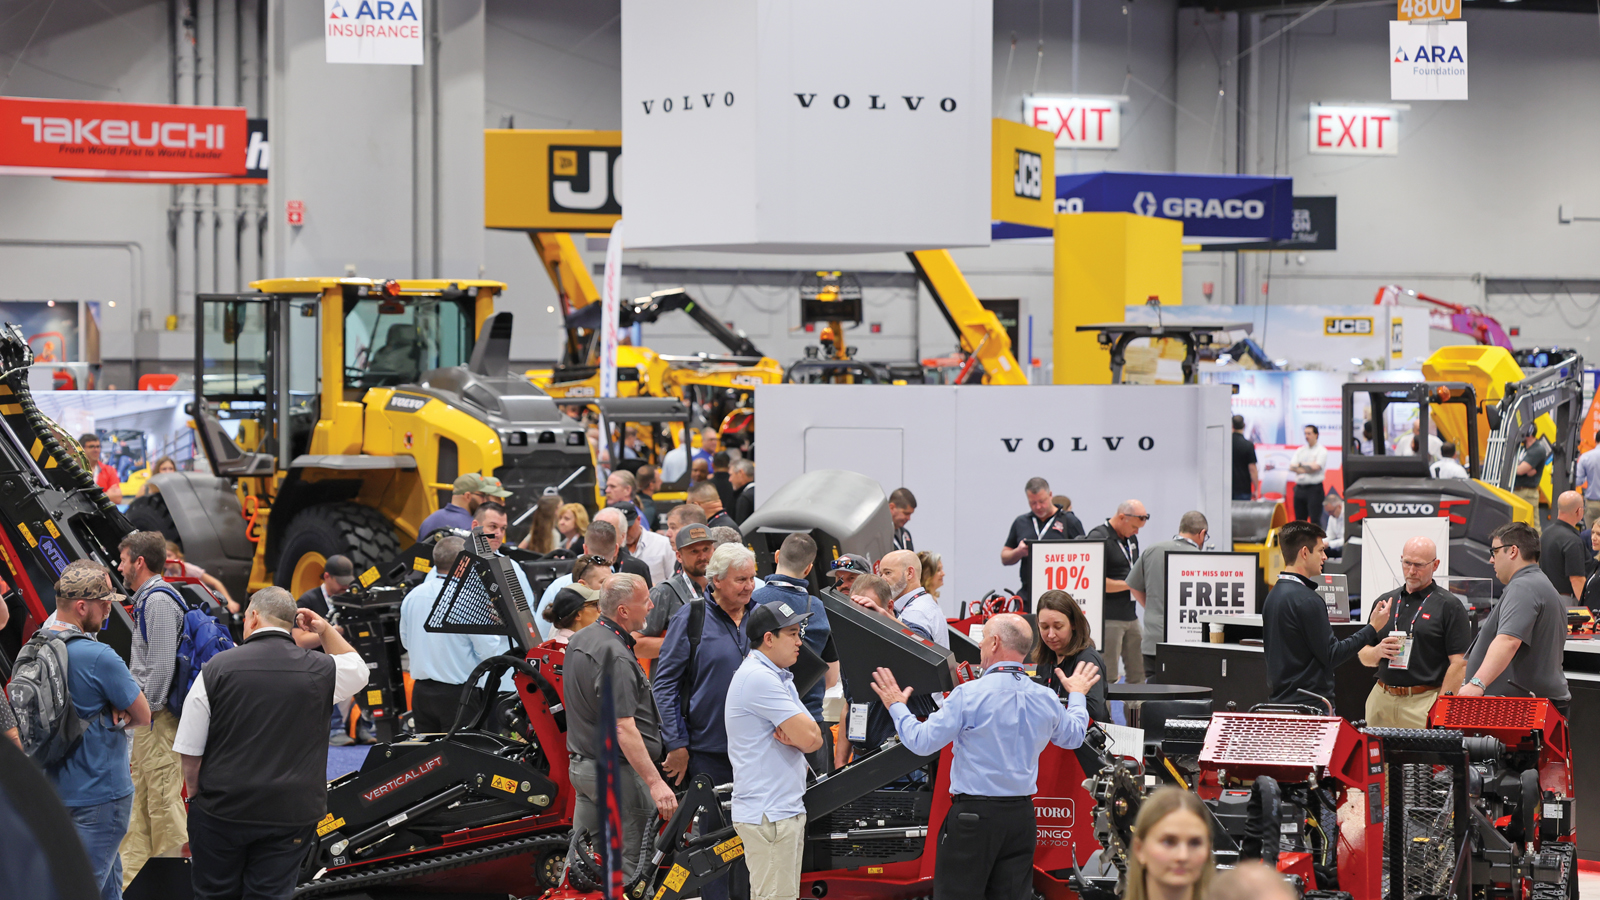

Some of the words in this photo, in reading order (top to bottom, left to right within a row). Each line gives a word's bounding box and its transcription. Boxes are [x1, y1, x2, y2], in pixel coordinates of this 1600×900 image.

[354, 0, 419, 21] ARA
[1400, 0, 1455, 17] 4800
[328, 24, 419, 39] INSURANCE
[1413, 45, 1465, 63] ARA
[1413, 66, 1466, 76] Foundation
[641, 91, 735, 115] VOLVO
[794, 93, 957, 113] VOLVO
[1033, 106, 1112, 142] EXIT
[1317, 114, 1391, 149] EXIT
[58, 144, 85, 155] From
[88, 146, 117, 156] World
[119, 147, 143, 157] First
[157, 149, 186, 159] World
[189, 150, 223, 160] Leader
[1014, 152, 1042, 198] JCB
[1162, 197, 1265, 220] GRACO
[1326, 319, 1372, 333] JCB
[391, 396, 425, 410] VOLVO
[1532, 394, 1556, 412] VOLVO
[1000, 436, 1155, 453] VOLVO
[1370, 502, 1434, 515] VOLVO
[1045, 554, 1065, 563] SAVE
[1067, 554, 1078, 562] UP
[1080, 553, 1090, 562] TO
[1044, 565, 1090, 590] 10%
[1179, 581, 1245, 607] FREE
[364, 770, 420, 801] VERTICAL
[419, 756, 442, 774] LIFT
[1034, 806, 1072, 818] TORO
